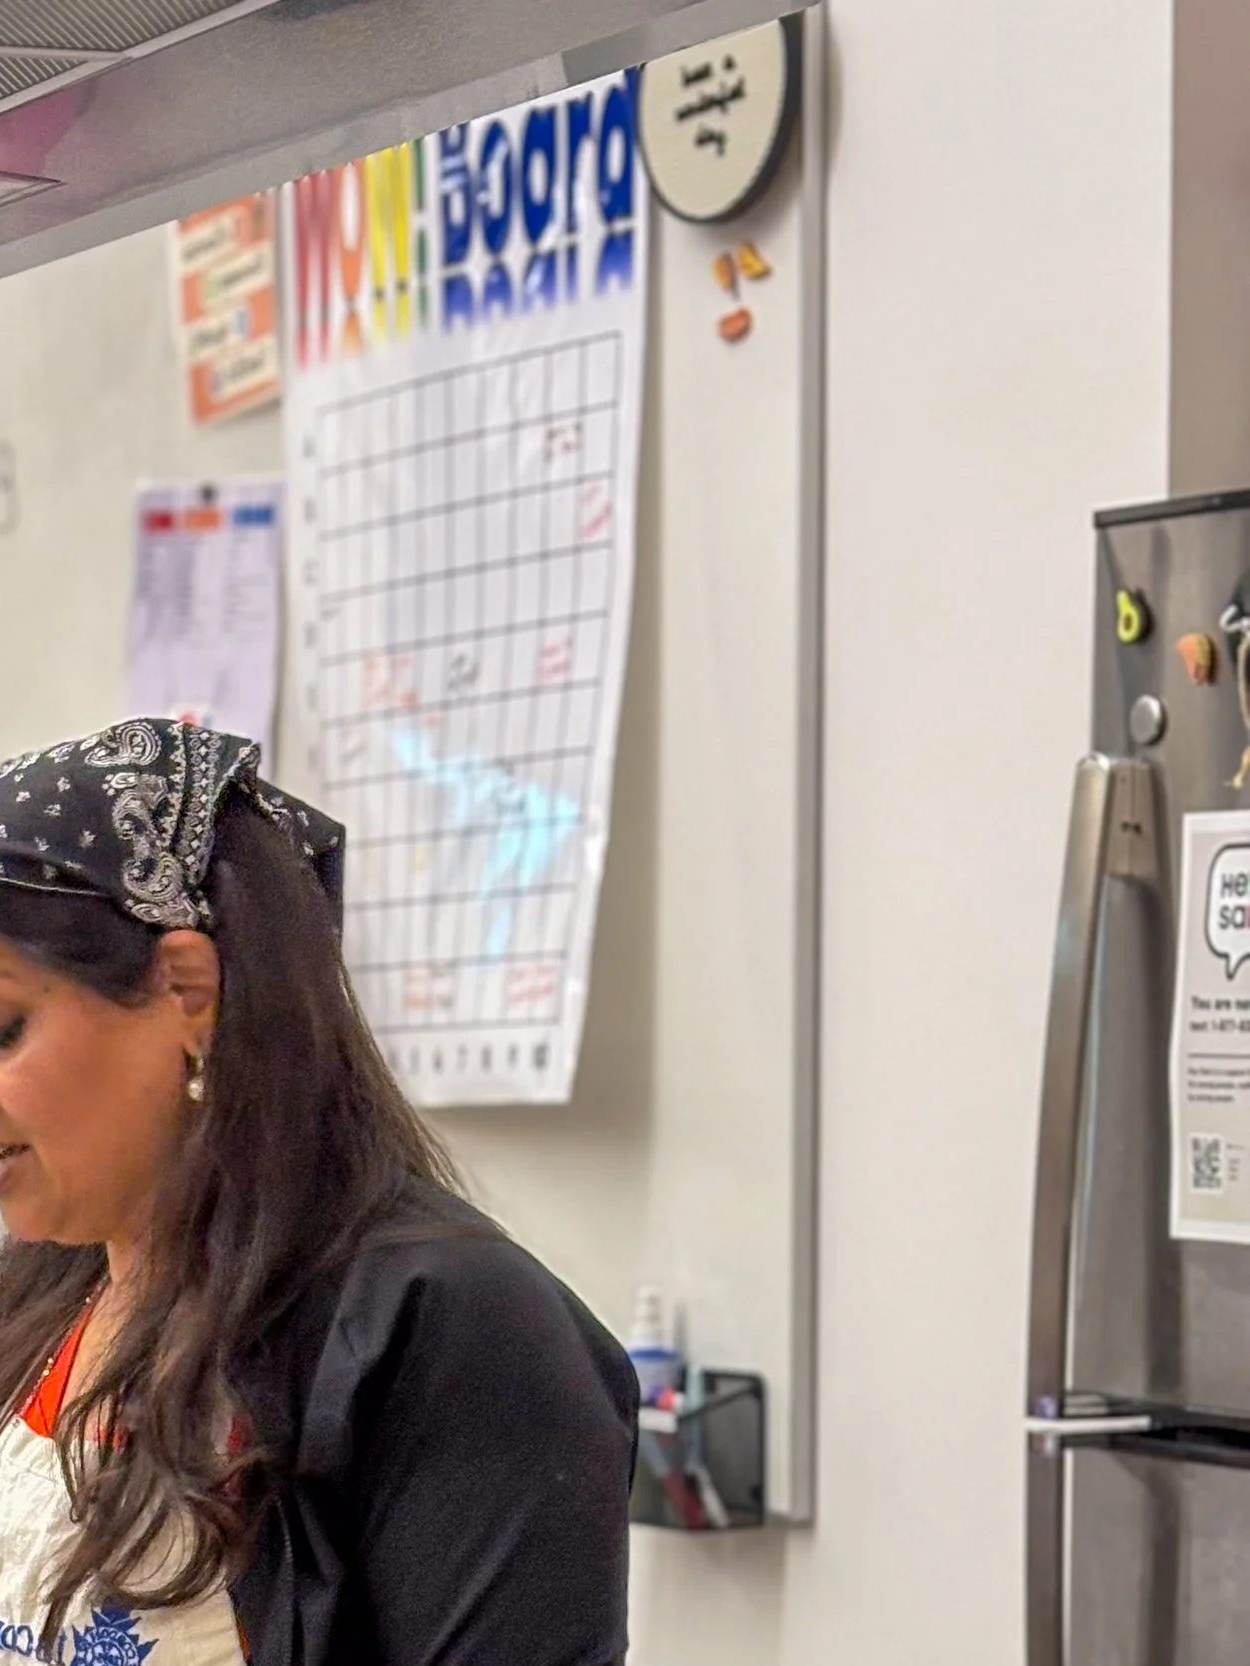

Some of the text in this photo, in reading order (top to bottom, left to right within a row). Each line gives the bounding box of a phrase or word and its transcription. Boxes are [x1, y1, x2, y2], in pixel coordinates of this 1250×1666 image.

[439, 66, 639, 267] Board
[1220, 871, 1250, 898] He
[1218, 904, 1250, 930] sa
